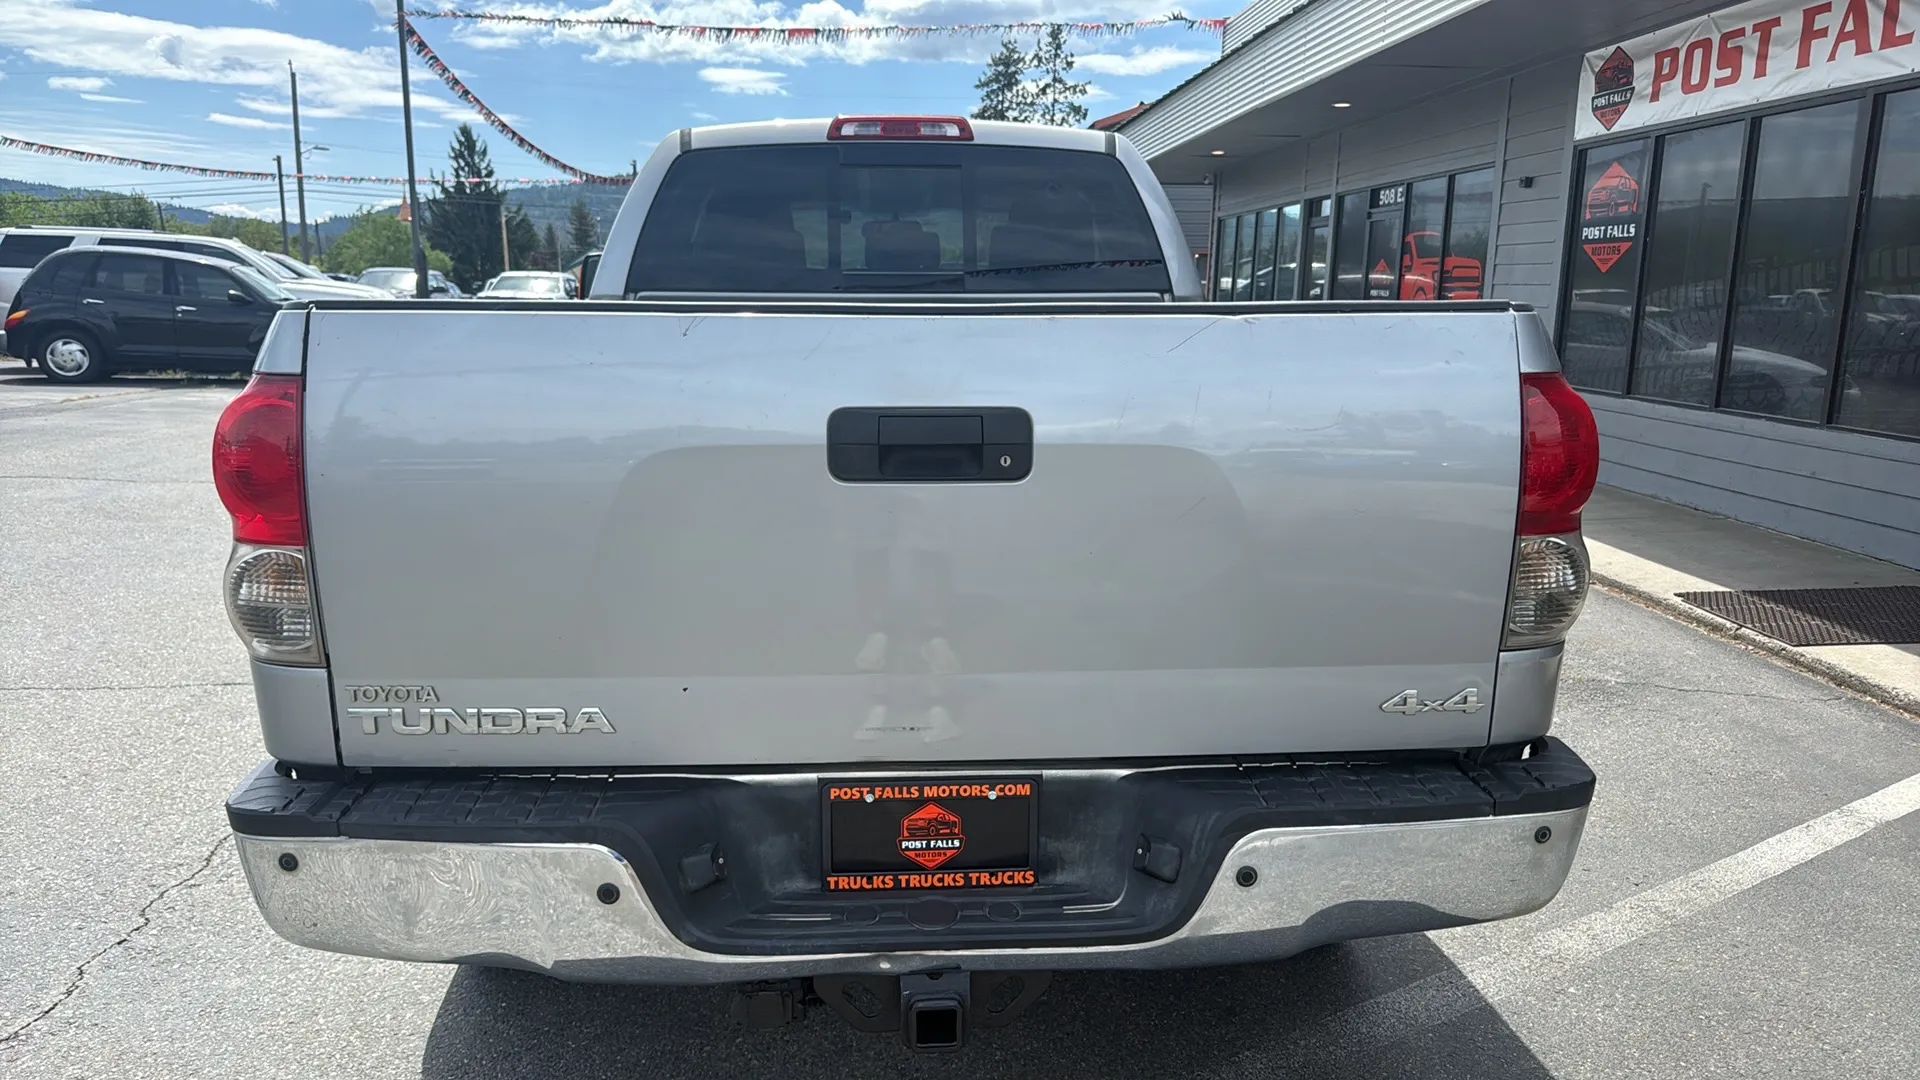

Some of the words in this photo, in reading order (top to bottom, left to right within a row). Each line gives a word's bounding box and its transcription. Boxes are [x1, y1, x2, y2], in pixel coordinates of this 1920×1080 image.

[1649, 16, 1782, 104] POST
[1794, 0, 1915, 70] FAL
[1593, 96, 1609, 108] POST
[1610, 90, 1632, 104] FALLS
[1379, 189, 1395, 205] 508
[1396, 187, 1404, 203] E.
[1582, 226, 1605, 240] POST
[1606, 224, 1636, 238] FALLS
[1591, 245, 1621, 257] MOTORS
[345, 685, 440, 702] TOYOTA
[1380, 688, 1485, 715] 4x4
[347, 707, 616, 735] TUNDRA
[830, 787, 870, 800] POST
[875, 786, 920, 799] FALLS
[924, 783, 1031, 798] MOTORSCOM
[902, 840, 928, 849] POST
[930, 839, 960, 848] FALLS
[827, 875, 894, 890] TRUCKS
[898, 873, 965, 888] TRUCKS
[969, 870, 1035, 886] TRUCKS
